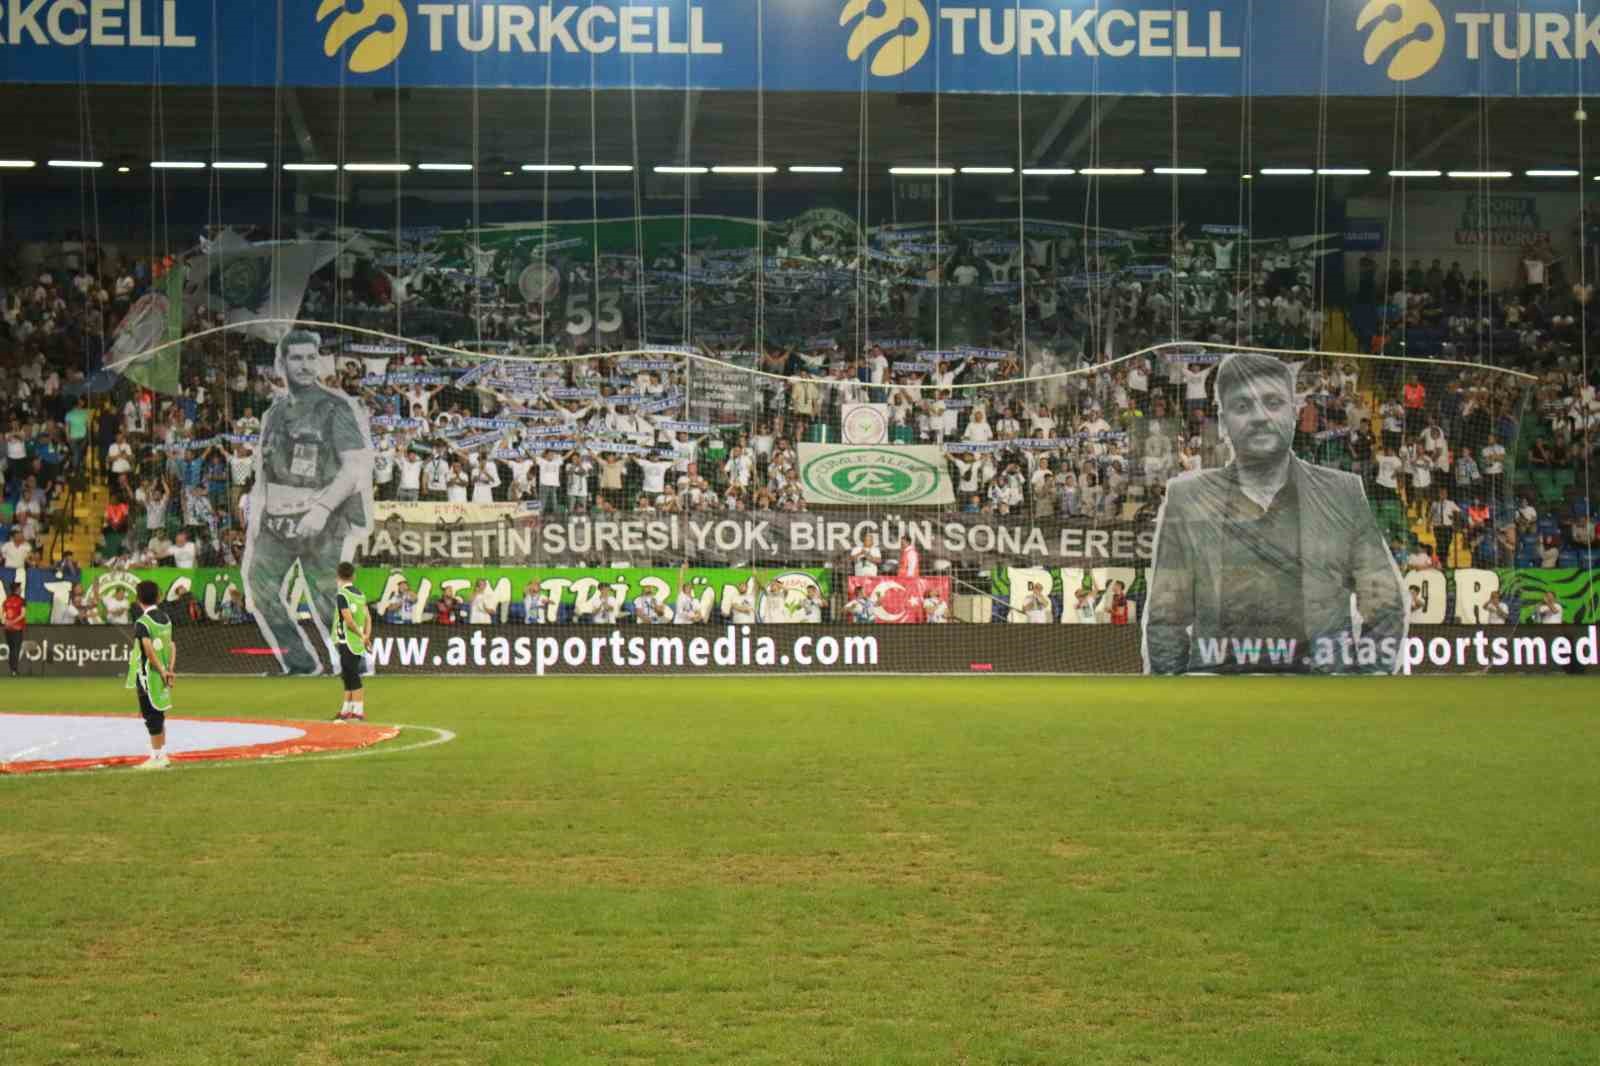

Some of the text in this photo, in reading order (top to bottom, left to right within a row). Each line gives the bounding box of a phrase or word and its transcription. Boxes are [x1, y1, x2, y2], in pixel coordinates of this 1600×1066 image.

[0, 0, 196, 47] KCELL
[418, 3, 722, 54] TURKCELL
[940, 7, 1240, 58] TURKCELL
[566, 291, 623, 335] 53
[543, 515, 679, 552] SÜRESİ
[690, 519, 779, 555] YOK,
[944, 522, 1048, 555] SONA
